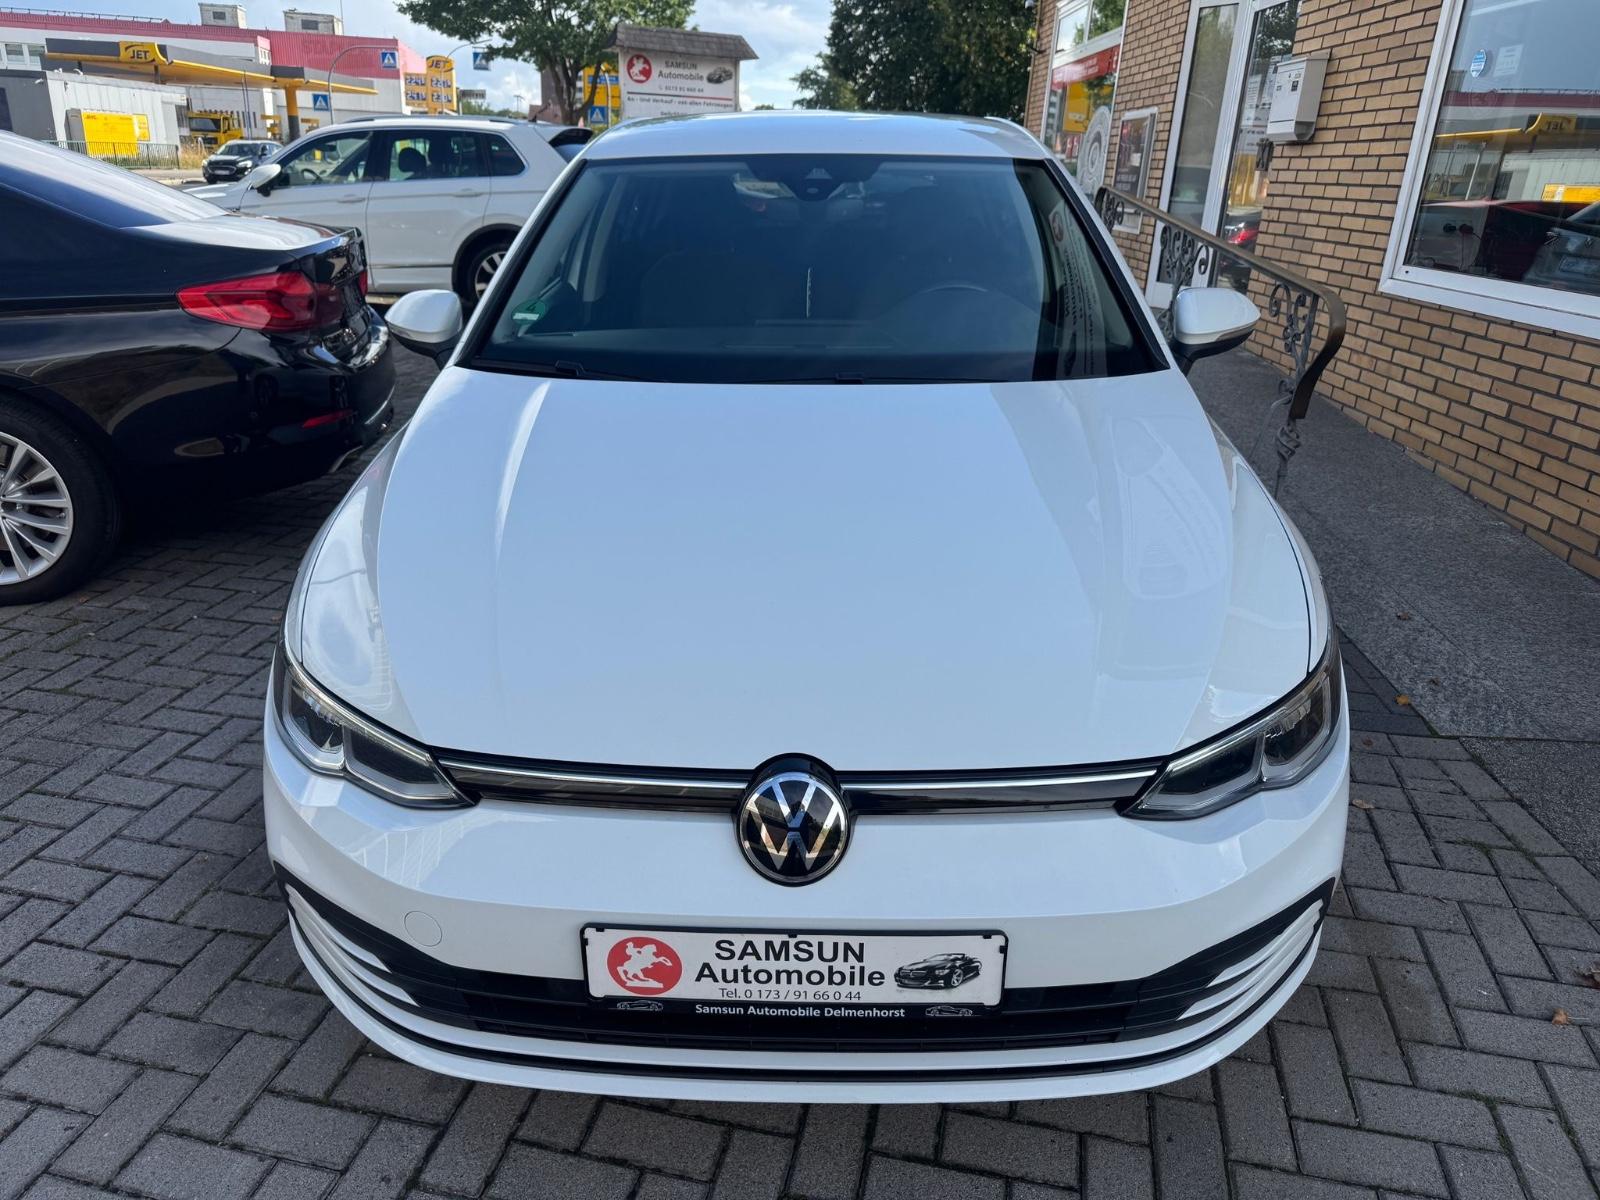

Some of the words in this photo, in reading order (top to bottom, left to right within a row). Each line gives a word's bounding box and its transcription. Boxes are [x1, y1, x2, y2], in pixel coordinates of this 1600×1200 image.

[130, 49, 150, 60] JET
[429, 59, 449, 69] JET
[665, 61, 697, 70] SAMSUN
[658, 70, 704, 80] Automobile
[714, 939, 865, 963] SAMSUN
[694, 962, 885, 987] Automobile
[719, 988, 741, 999] Tel.
[695, 1004, 744, 1015] Samsun
[747, 1005, 820, 1017] Automobile
[824, 1007, 905, 1018] Delmenhorst
